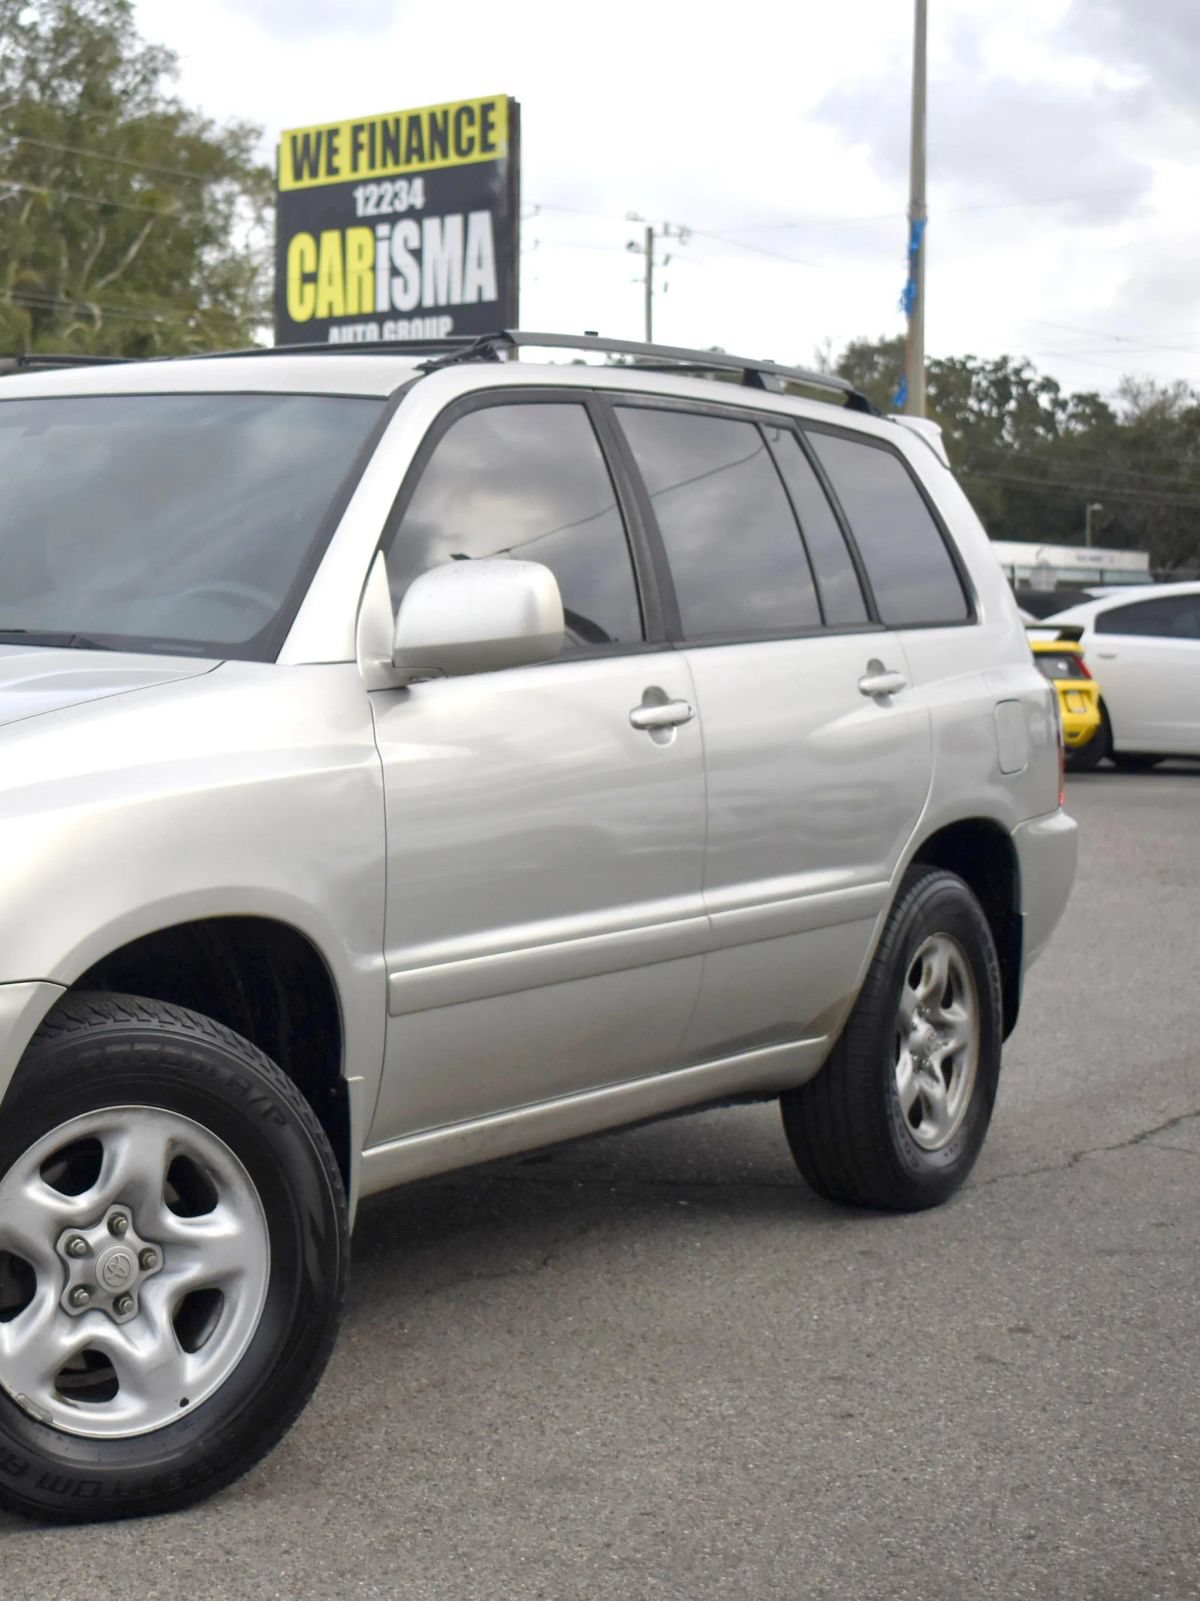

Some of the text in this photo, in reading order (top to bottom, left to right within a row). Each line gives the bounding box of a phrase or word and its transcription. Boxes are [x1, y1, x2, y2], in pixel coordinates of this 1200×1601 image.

[290, 101, 497, 182] WE FINANCE
[353, 176, 426, 218] 12234
[328, 315, 454, 344] AUTO GROUP
